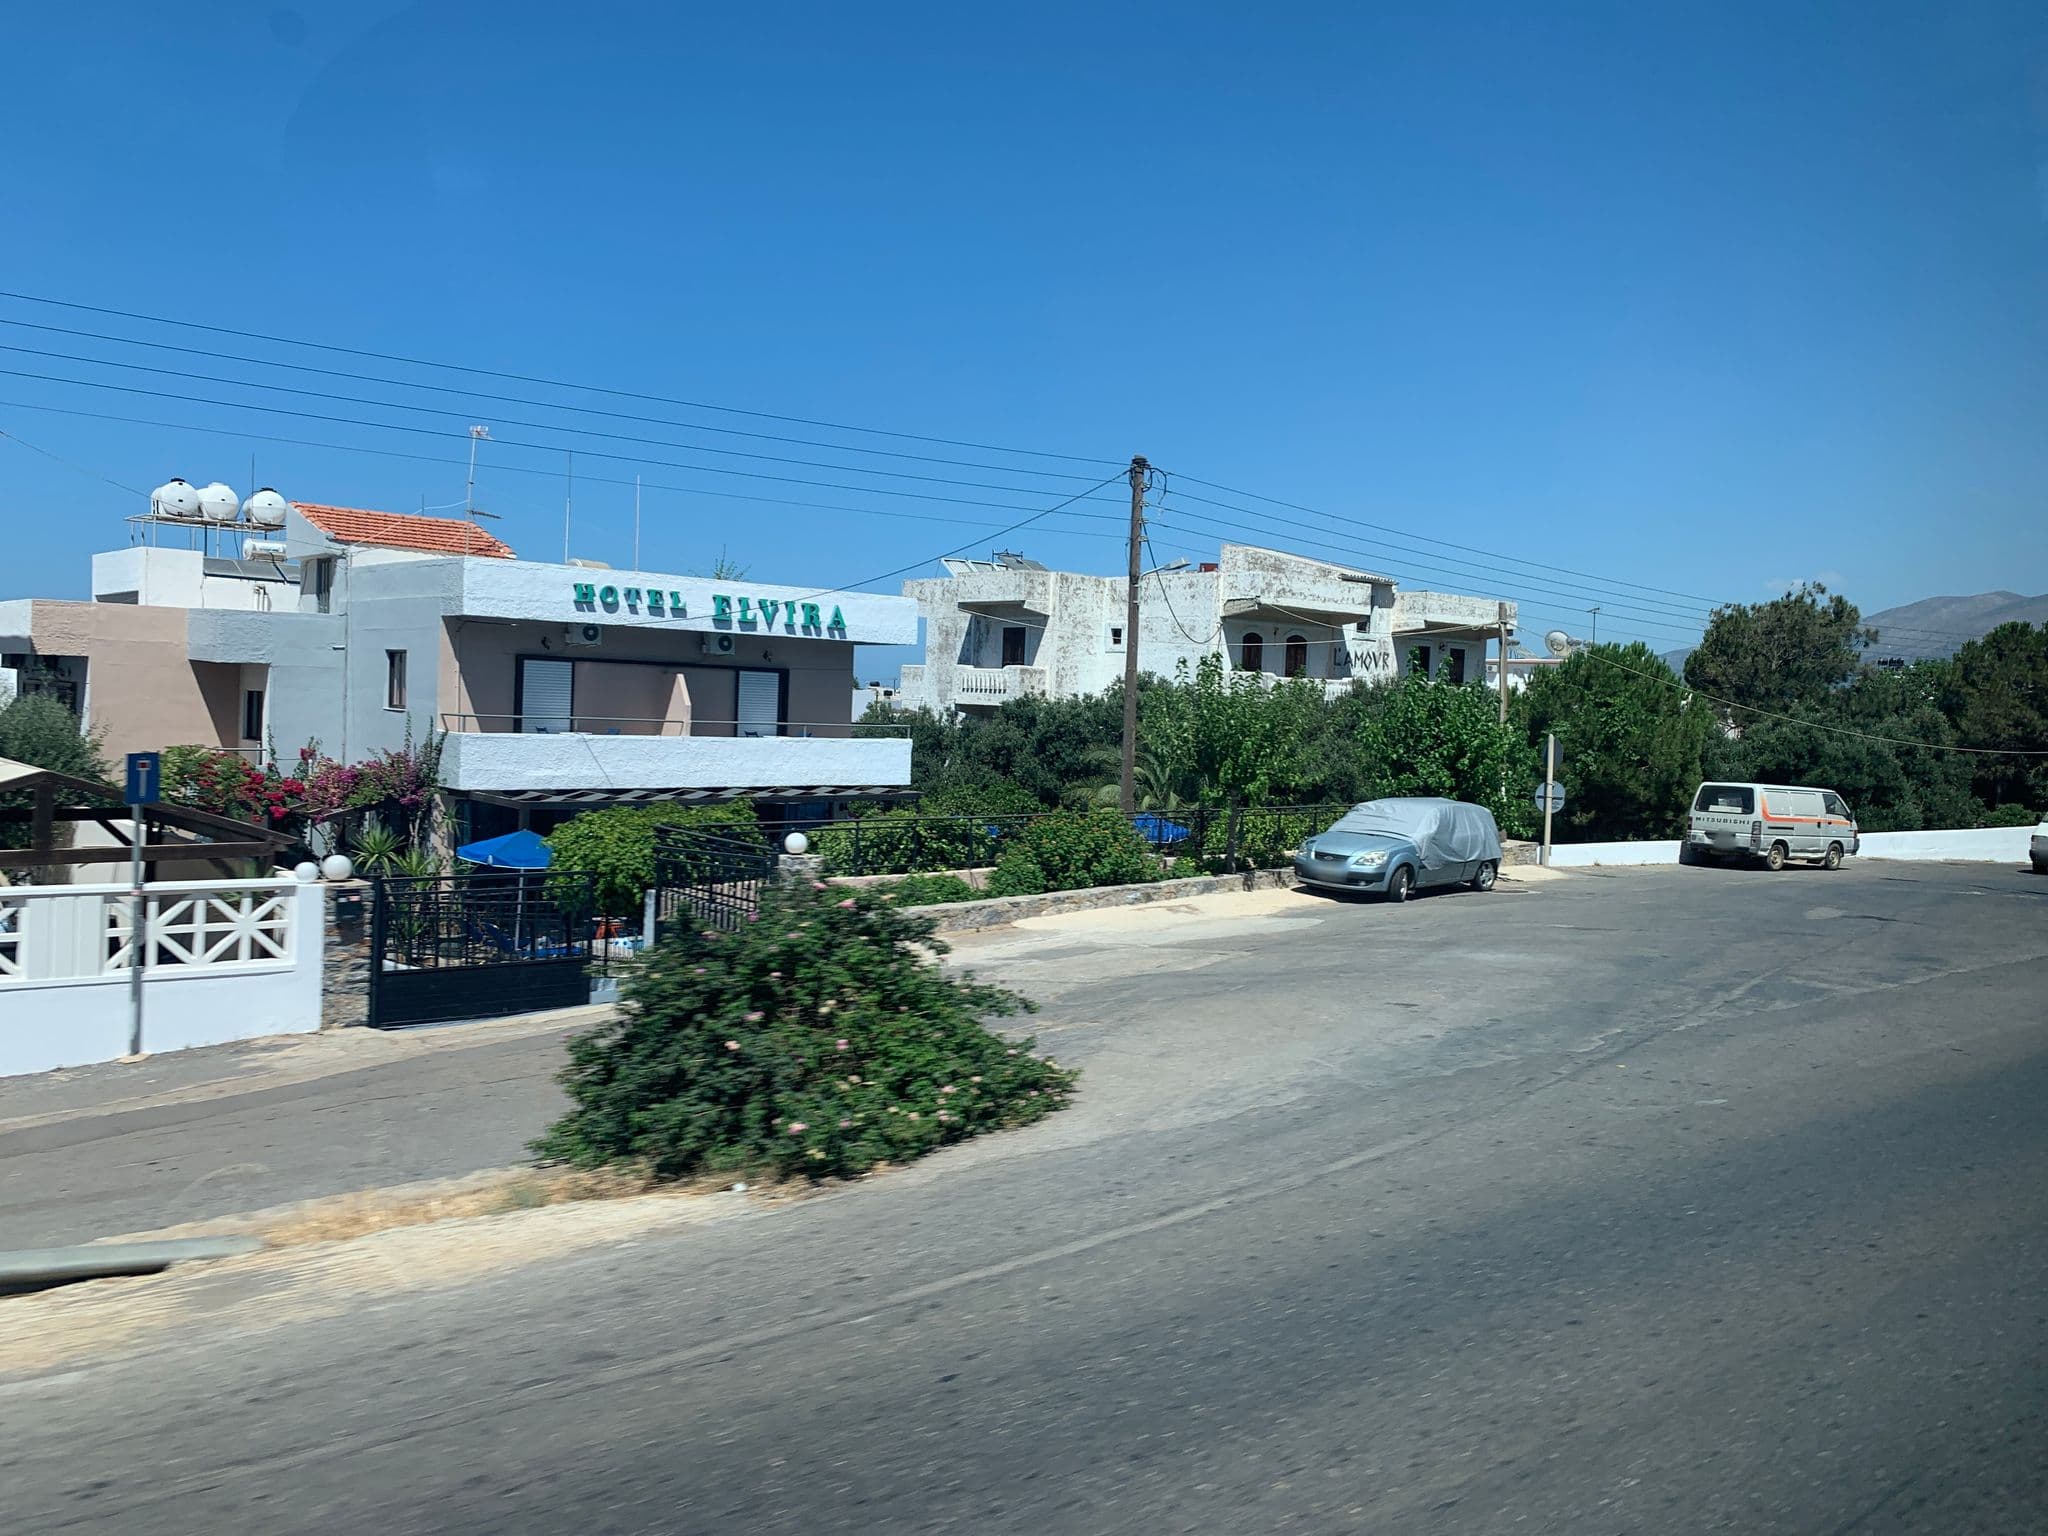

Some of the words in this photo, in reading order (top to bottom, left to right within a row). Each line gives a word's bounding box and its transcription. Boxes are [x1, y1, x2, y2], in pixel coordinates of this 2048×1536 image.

[573, 582, 687, 611] HOTEL
[712, 594, 847, 630] ELVIRA
[1695, 816, 1750, 825] MITSUBISHI
